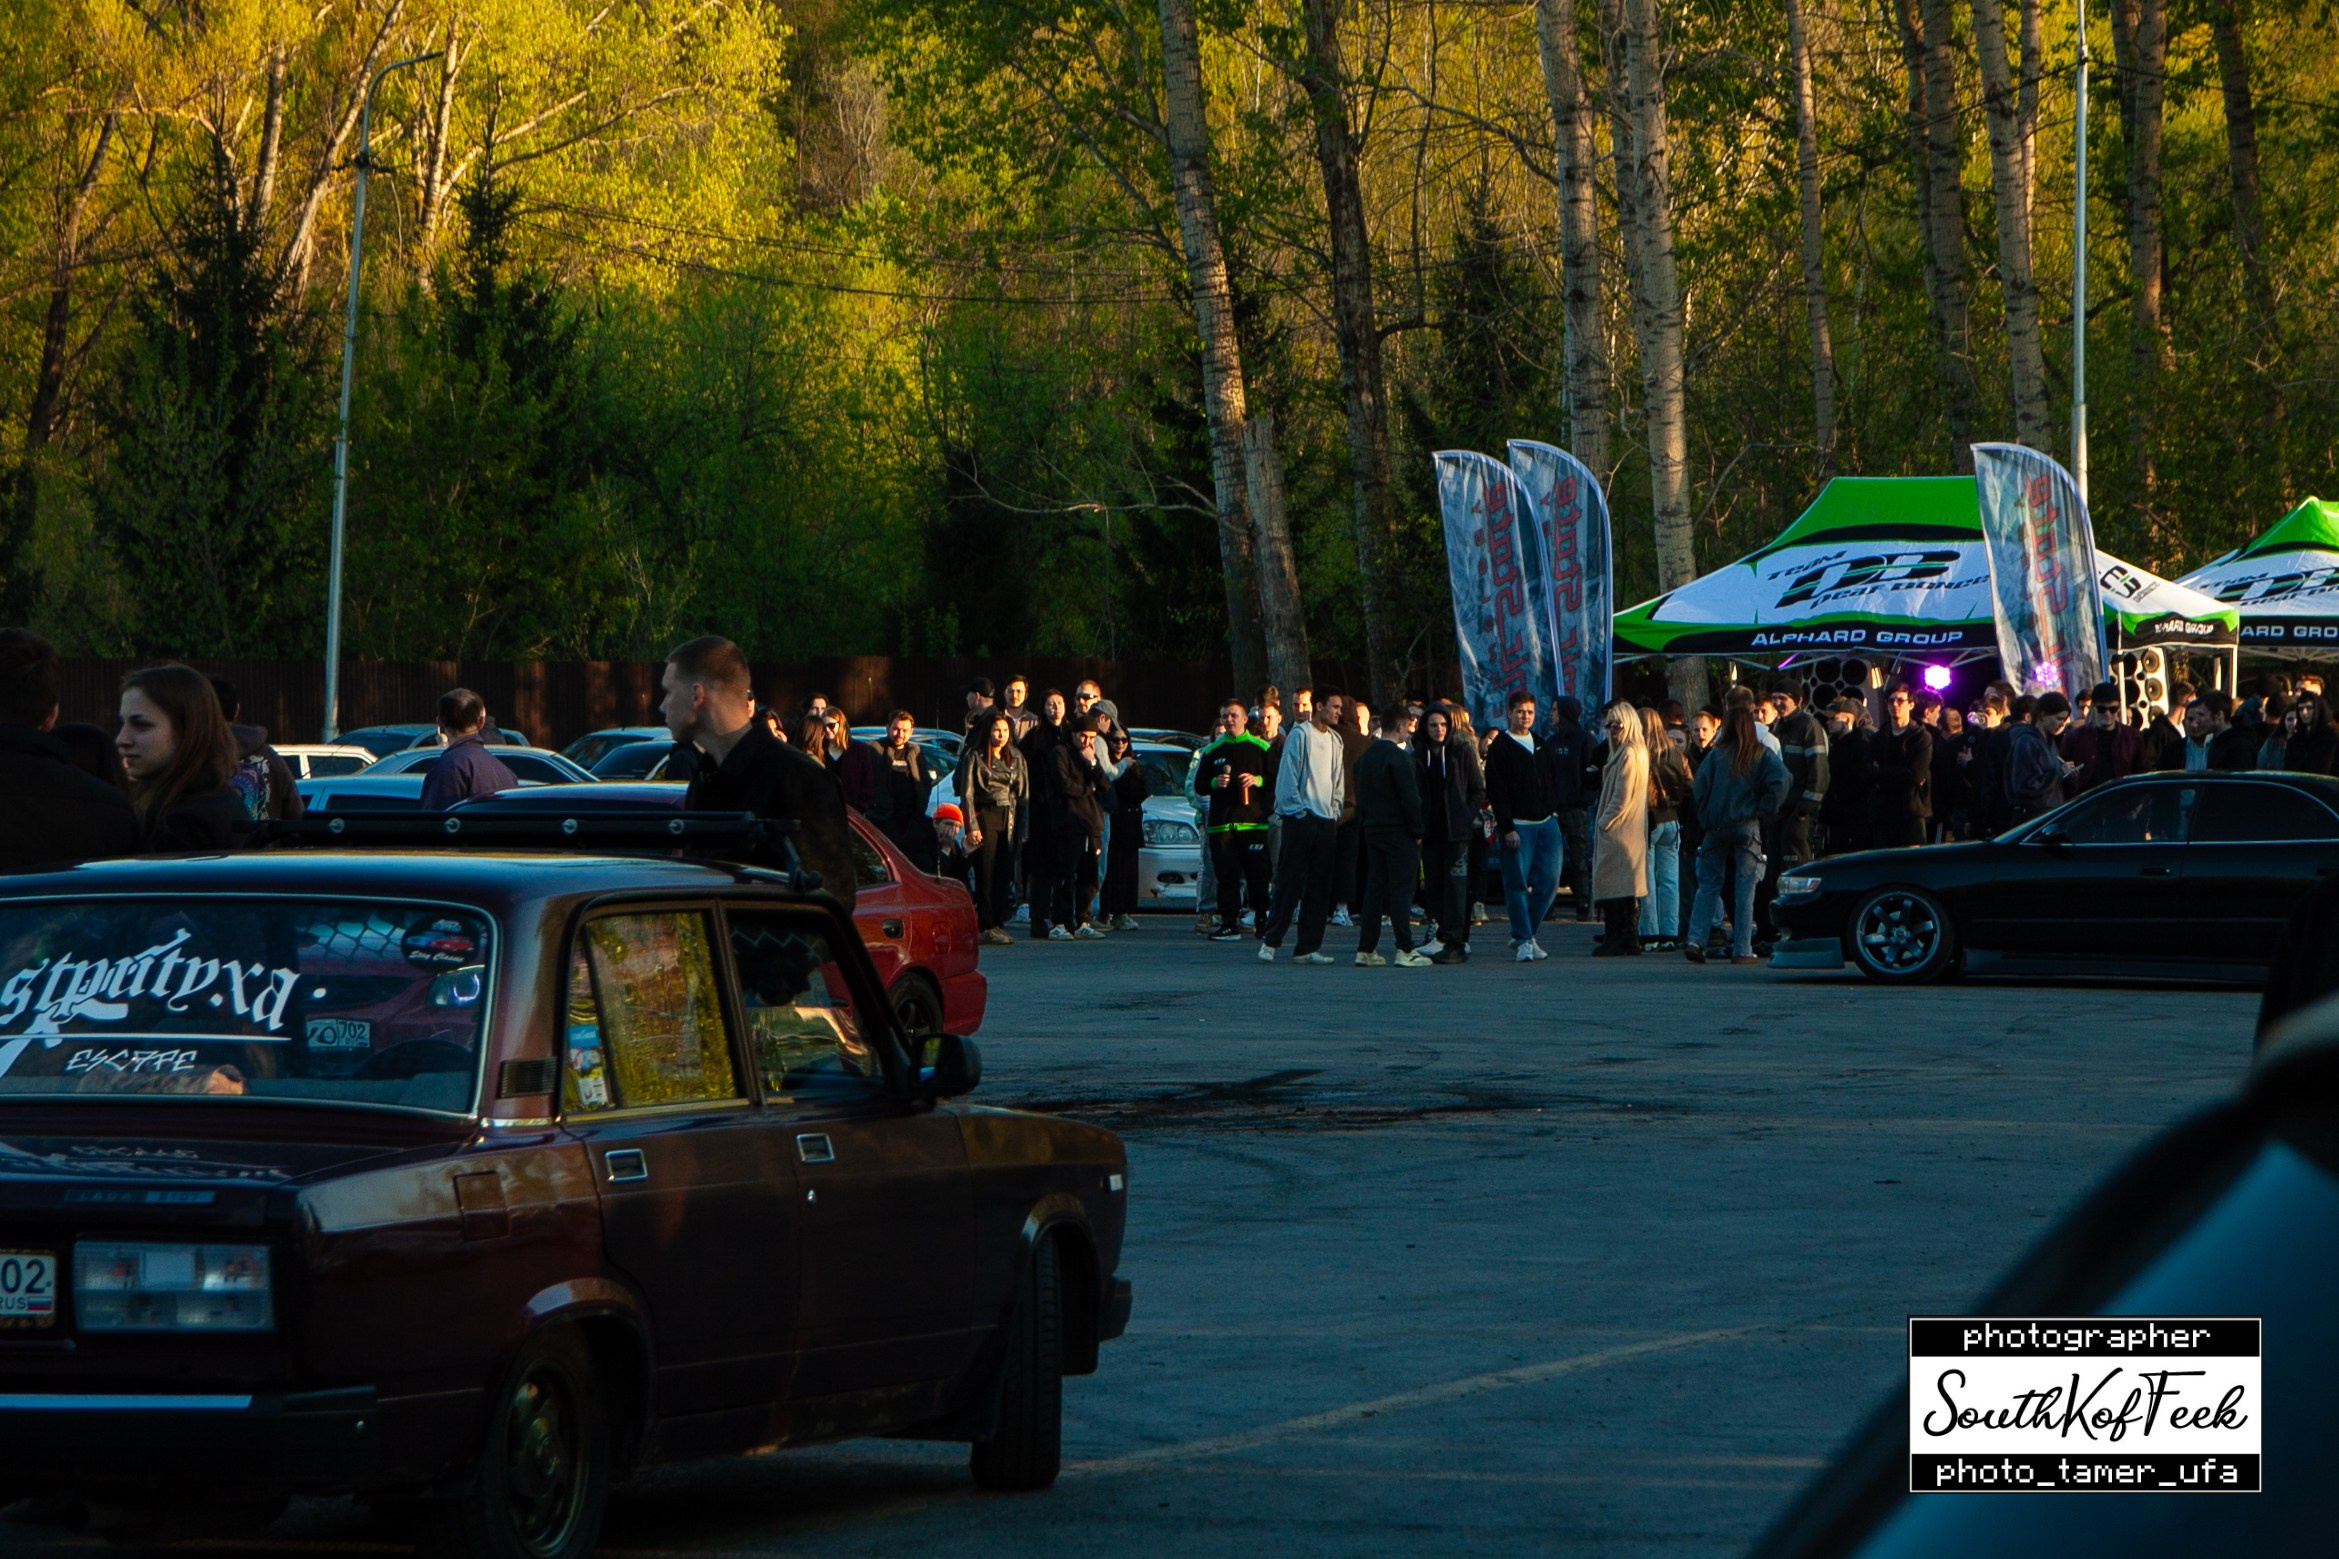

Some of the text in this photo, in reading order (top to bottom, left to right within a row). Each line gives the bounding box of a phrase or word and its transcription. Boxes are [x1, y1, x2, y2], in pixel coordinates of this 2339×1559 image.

[1750, 629, 1963, 647] ALPHARD GROUP
[338, 1020, 366, 1040] 702
[1, 1258, 46, 1294] 02
